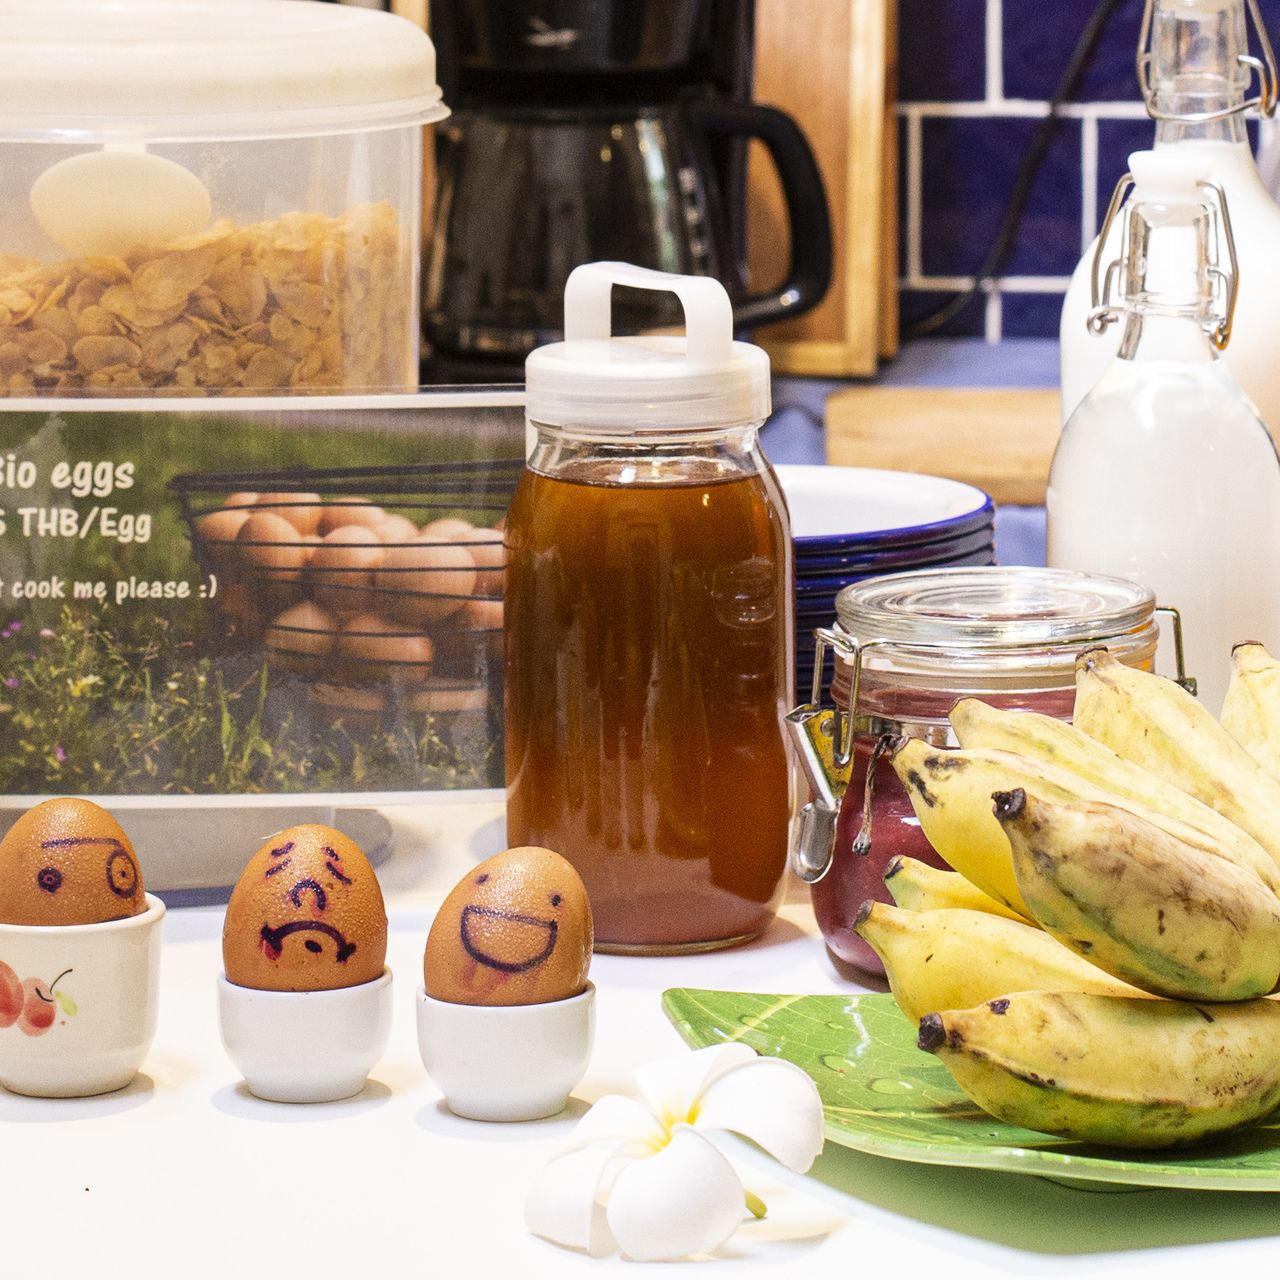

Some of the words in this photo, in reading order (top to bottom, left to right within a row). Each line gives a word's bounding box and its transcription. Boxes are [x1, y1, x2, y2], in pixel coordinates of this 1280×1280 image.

[50, 460, 136, 498] eggs
[18, 505, 152, 543] THB/Egg
[11, 575, 66, 599] cook
[73, 583, 108, 599] me
[115, 575, 191, 605] please
